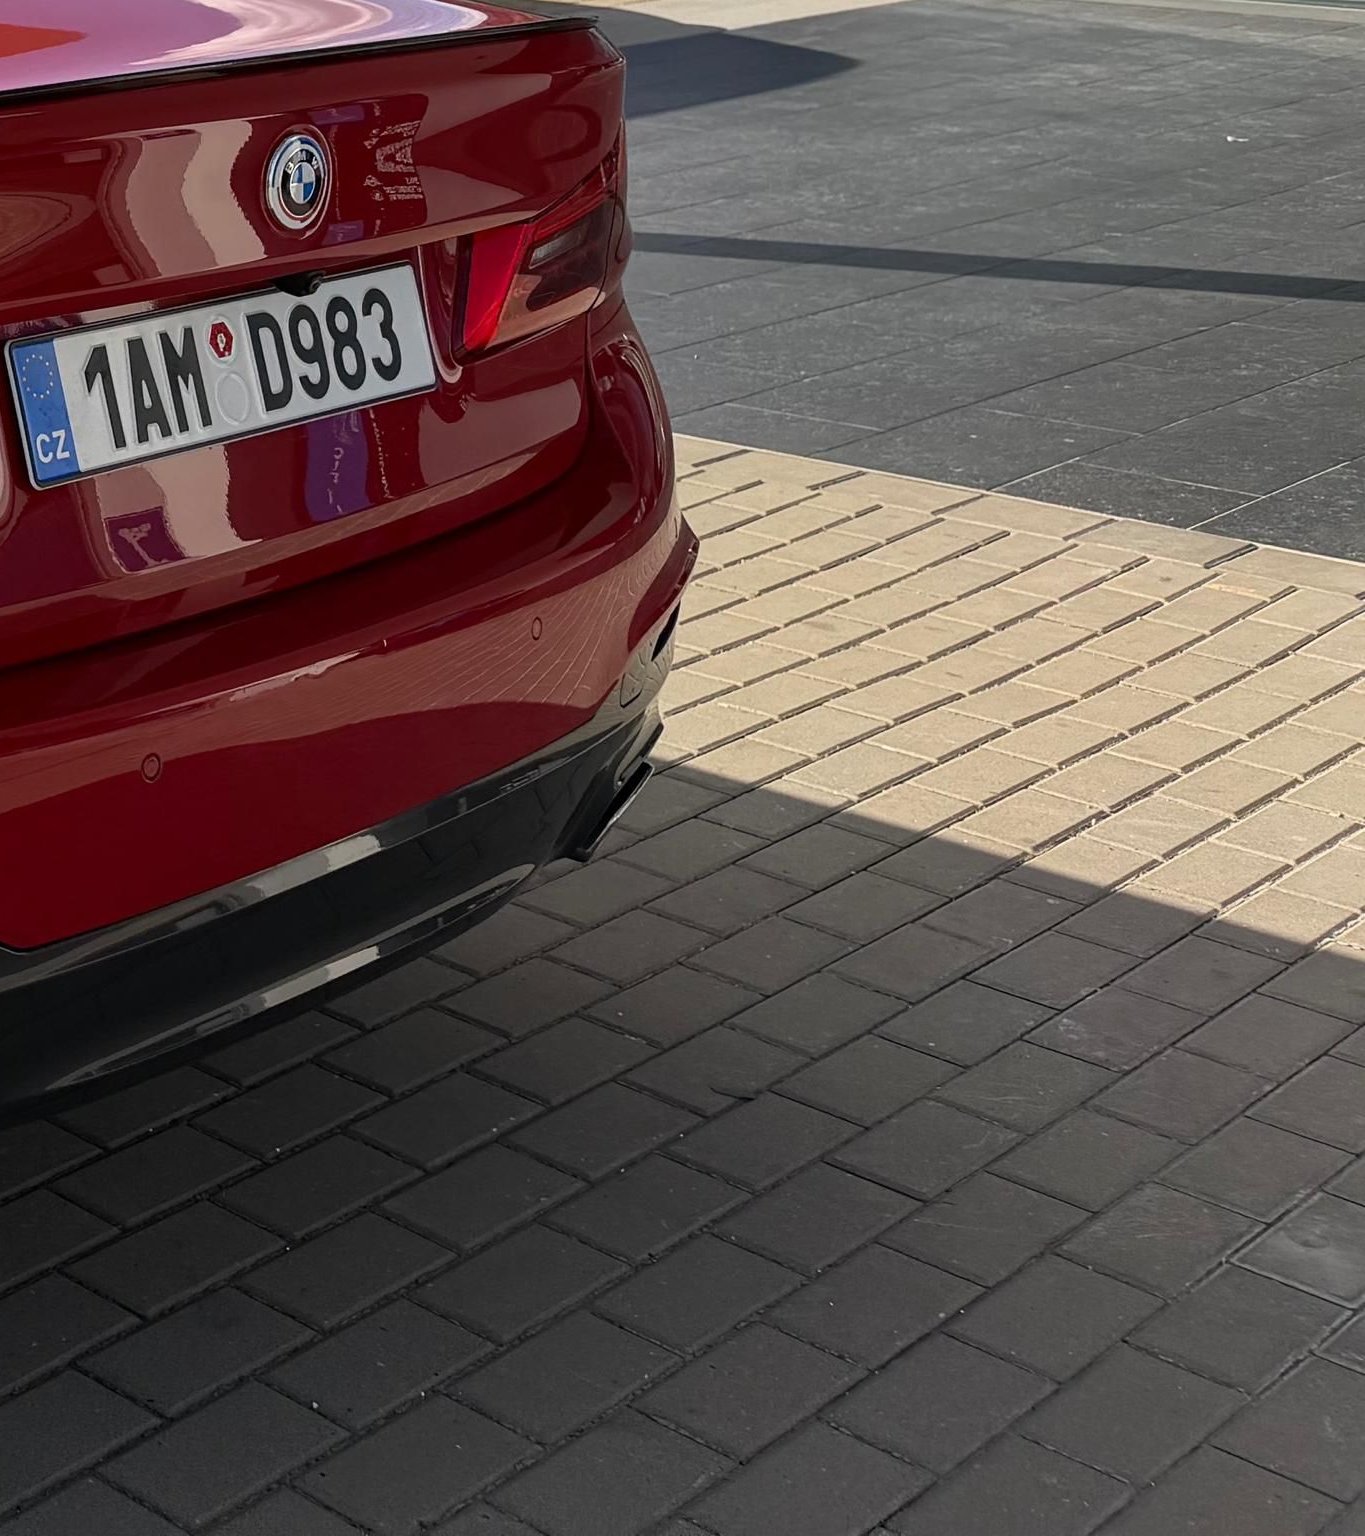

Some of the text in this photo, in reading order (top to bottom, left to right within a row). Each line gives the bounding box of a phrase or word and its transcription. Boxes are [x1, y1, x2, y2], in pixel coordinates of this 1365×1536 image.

[84, 288, 401, 449] 1AM D983
[36, 431, 70, 464] CZ
